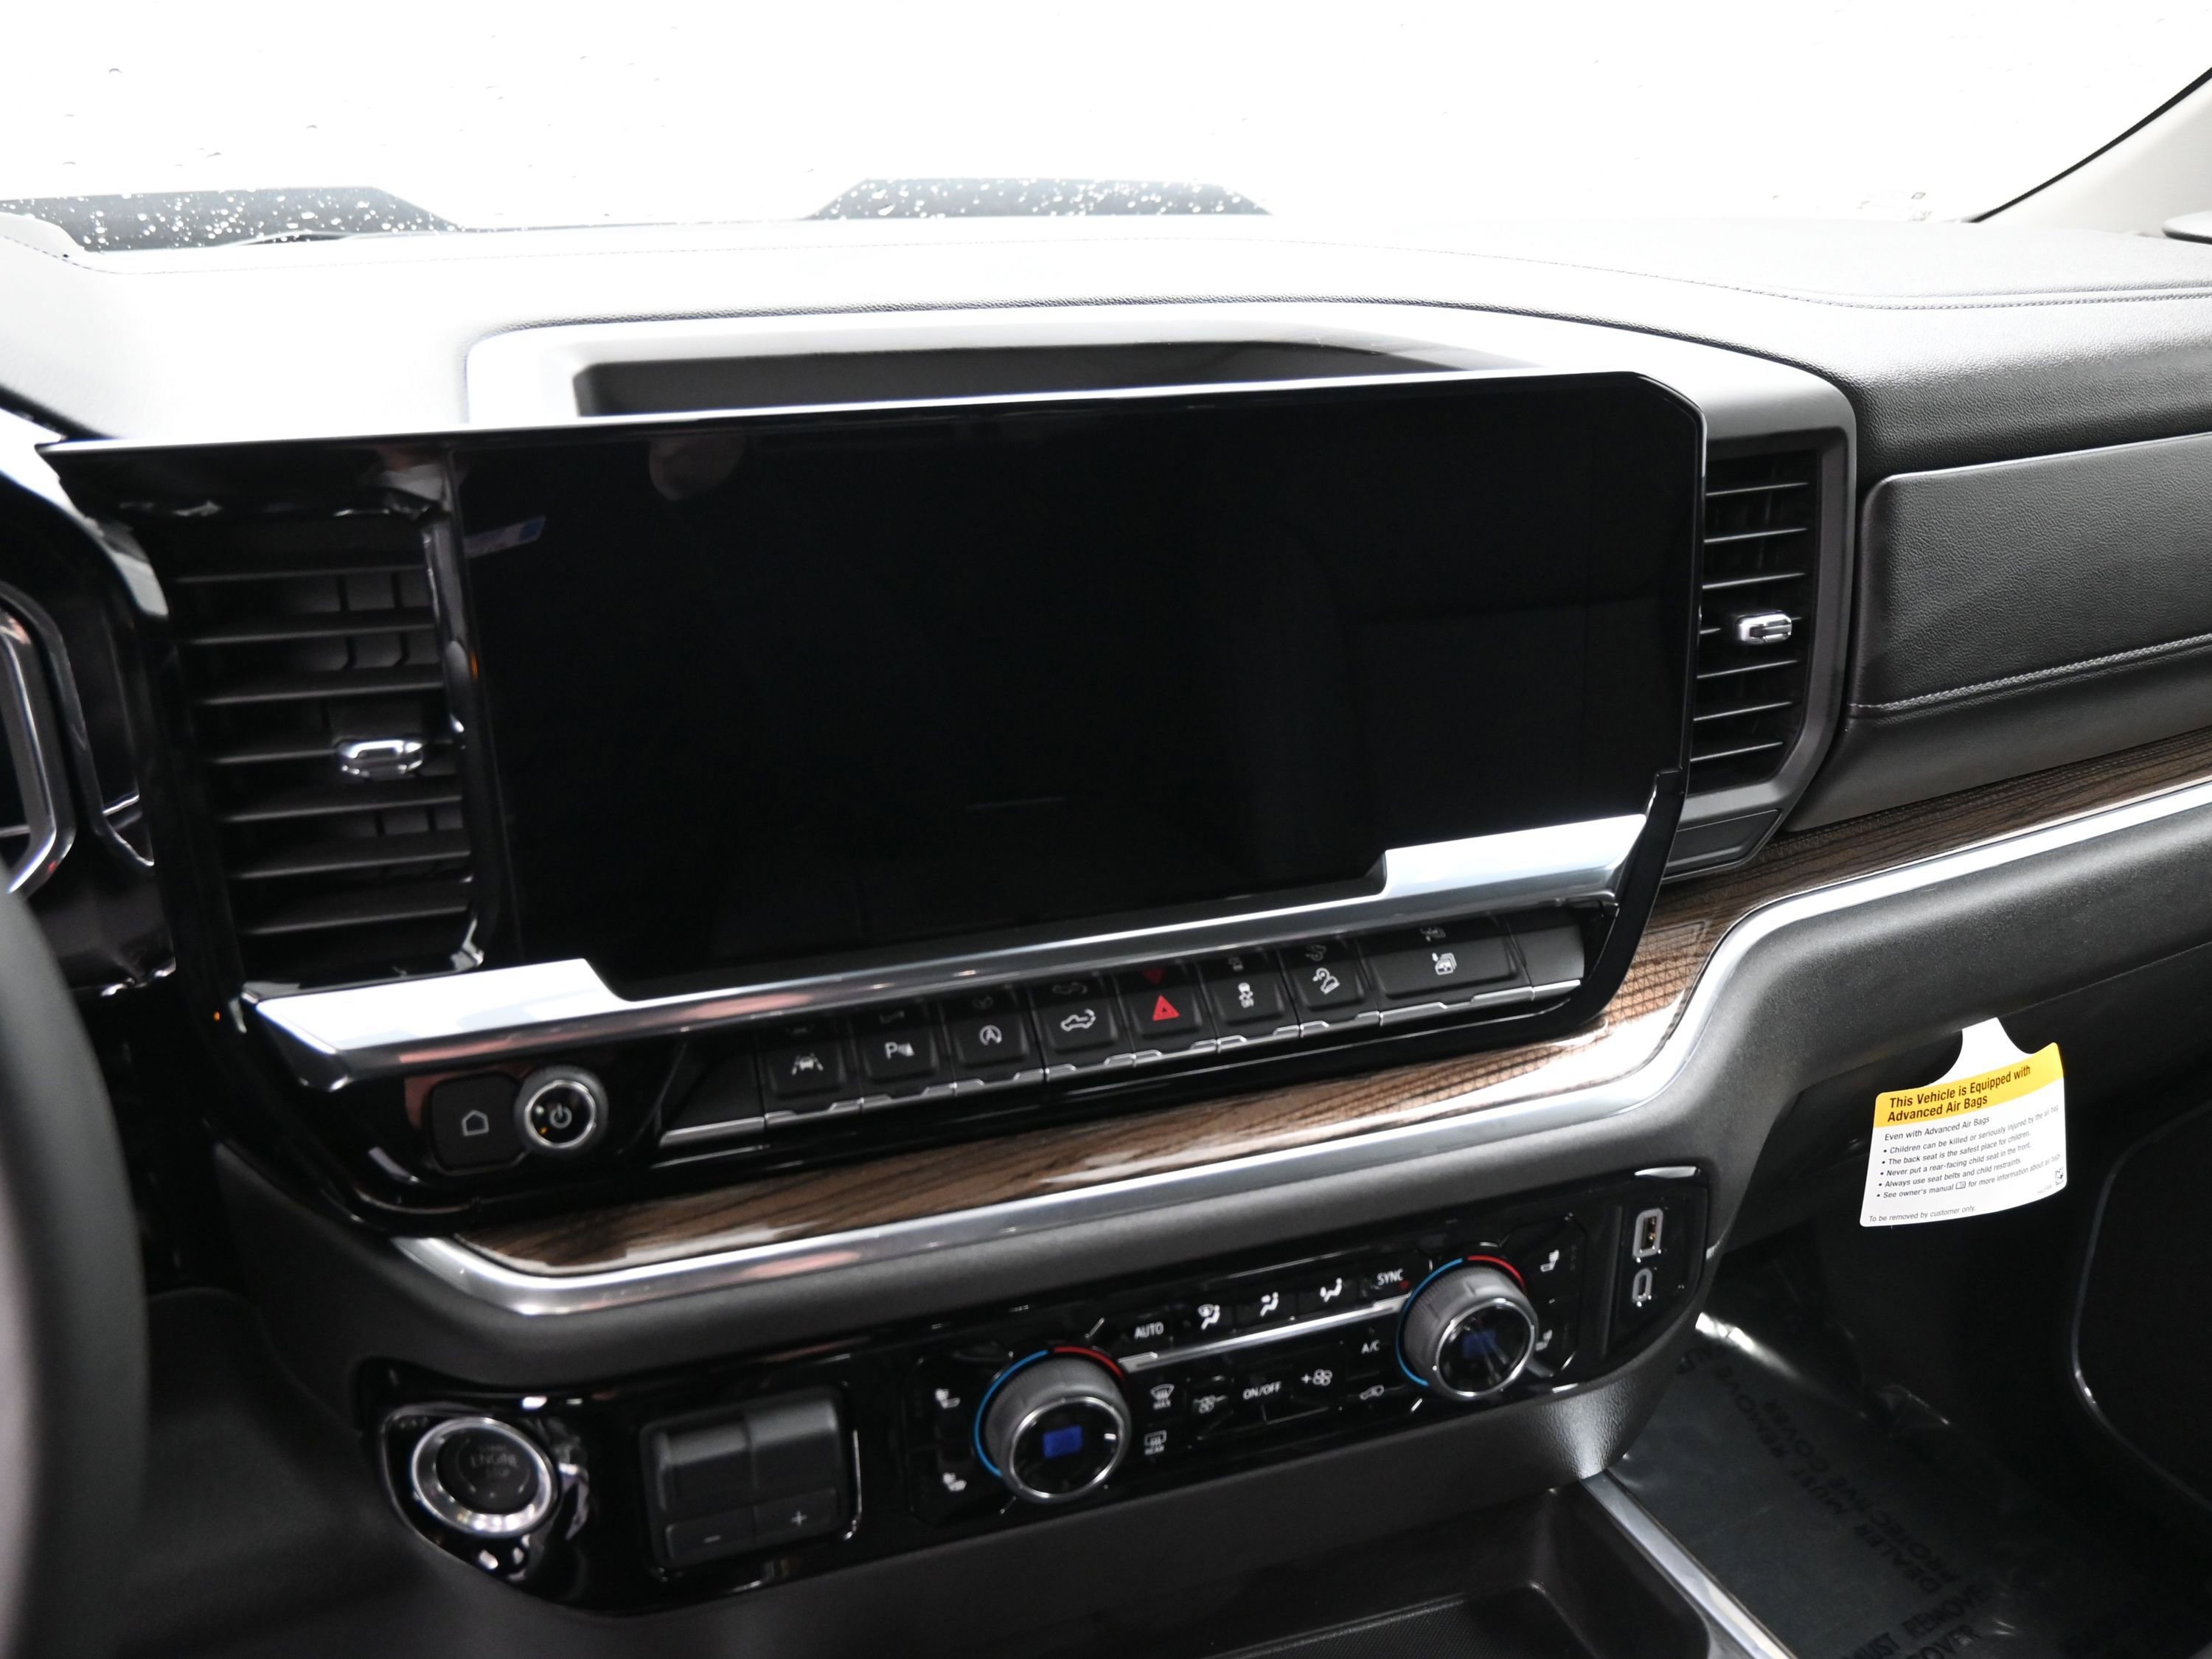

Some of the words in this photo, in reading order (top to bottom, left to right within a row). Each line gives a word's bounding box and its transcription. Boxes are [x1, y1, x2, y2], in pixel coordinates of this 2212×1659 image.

[1890, 1097, 1913, 1109] This
[1917, 1088, 1955, 1105] Vehicle
[1958, 1086, 1966, 1096] is
[1970, 1071, 2011, 1093] Equipped
[2014, 1065, 2031, 1081] with
[1888, 1107, 1942, 1122] Advanced
[1946, 1102, 1960, 1114] Air
[1964, 1095, 1988, 1110] Bags
[1890, 1144, 1921, 1154] Children
[1923, 1142, 1936, 1150] can
[1949, 1136, 1968, 1145] killed
[1978, 1127, 2006, 1140] seriously
[2007, 1119, 2027, 1131] injured
[2028, 1116, 2034, 1124] by
[1905, 1128, 1922, 1139] with
[1924, 1123, 1961, 1136] Advanced
[1962, 1120, 1972, 1129] Air
[1973, 1116, 1990, 1127] Bags
[1886, 1169, 1908, 1177] Never
[1910, 1166, 1921, 1175] put
[1930, 1160, 1967, 1172] rear-facing
[1969, 1155, 1985, 1165] child
[1986, 1152, 1999, 1161] seat
[2008, 1147, 2016, 1155] the
[1903, 1155, 1921, 1164] back
[1922, 1152, 1938, 1161] seat
[1947, 1148, 1958, 1157] the
[1959, 1145, 1980, 1155] safest
[1980, 1141, 1997, 1152] place
[1883, 1191, 1897, 1199] See
[1899, 1187, 1927, 1197] owner's
[1929, 1183, 1954, 1194] manual
[1968, 1180, 1977, 1188] for
[1979, 1176, 1995, 1186] more
[1997, 1166, 2029, 1182] information
[2030, 1161, 2044, 1172] about
[1885, 1180, 1911, 1188] Always
[1927, 1175, 1942, 1183] seat
[1944, 1172, 1961, 1180] belts
[1962, 1169, 1975, 1177] and
[1977, 1165, 1992, 1175] child
[1994, 1158, 2022, 1171] restraints.
[1889, 1212, 1918, 1221] removed
[1920, 1210, 1928, 1219] by
[1930, 1206, 1960, 1217] customer
[1961, 1205, 1976, 1214] only.
[1377, 1269, 1404, 1287] SYNC
[1134, 1321, 1164, 1339] AUTO
[1360, 1340, 1380, 1355] A/C
[1242, 1380, 1282, 1401] ON/OFF
[1855, 1523, 1941, 1593] DEALER
[1902, 1585, 1991, 1638] REMOVE
